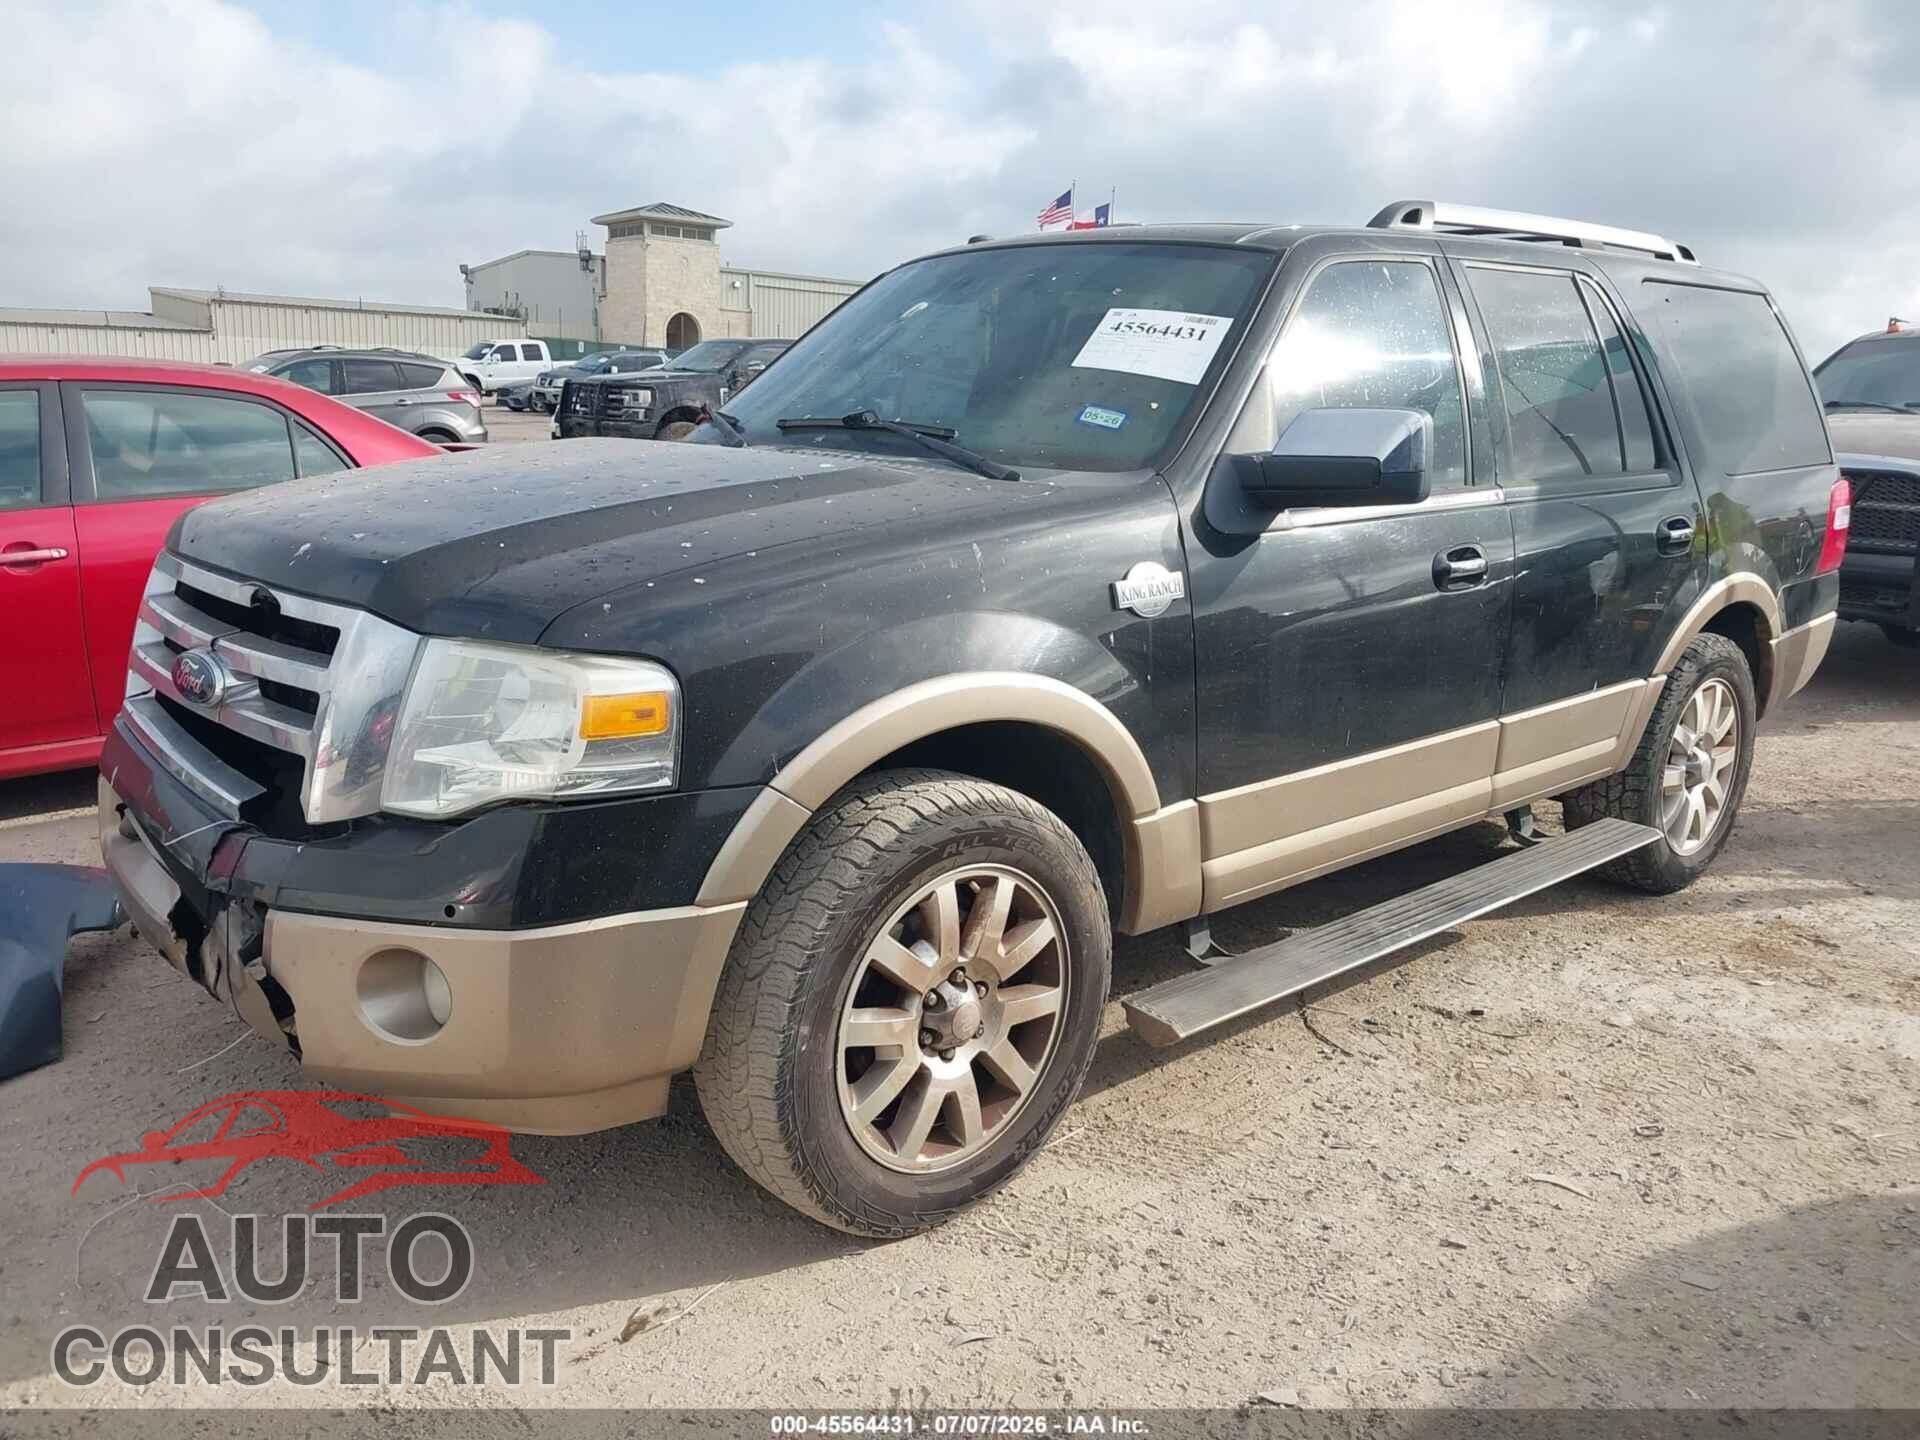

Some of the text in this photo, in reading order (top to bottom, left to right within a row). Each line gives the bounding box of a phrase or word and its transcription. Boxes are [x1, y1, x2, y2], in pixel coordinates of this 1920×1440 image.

[1110, 320, 1208, 342] 45564431
[1120, 575, 1184, 602] KING RANCH
[176, 658, 206, 694] Ford
